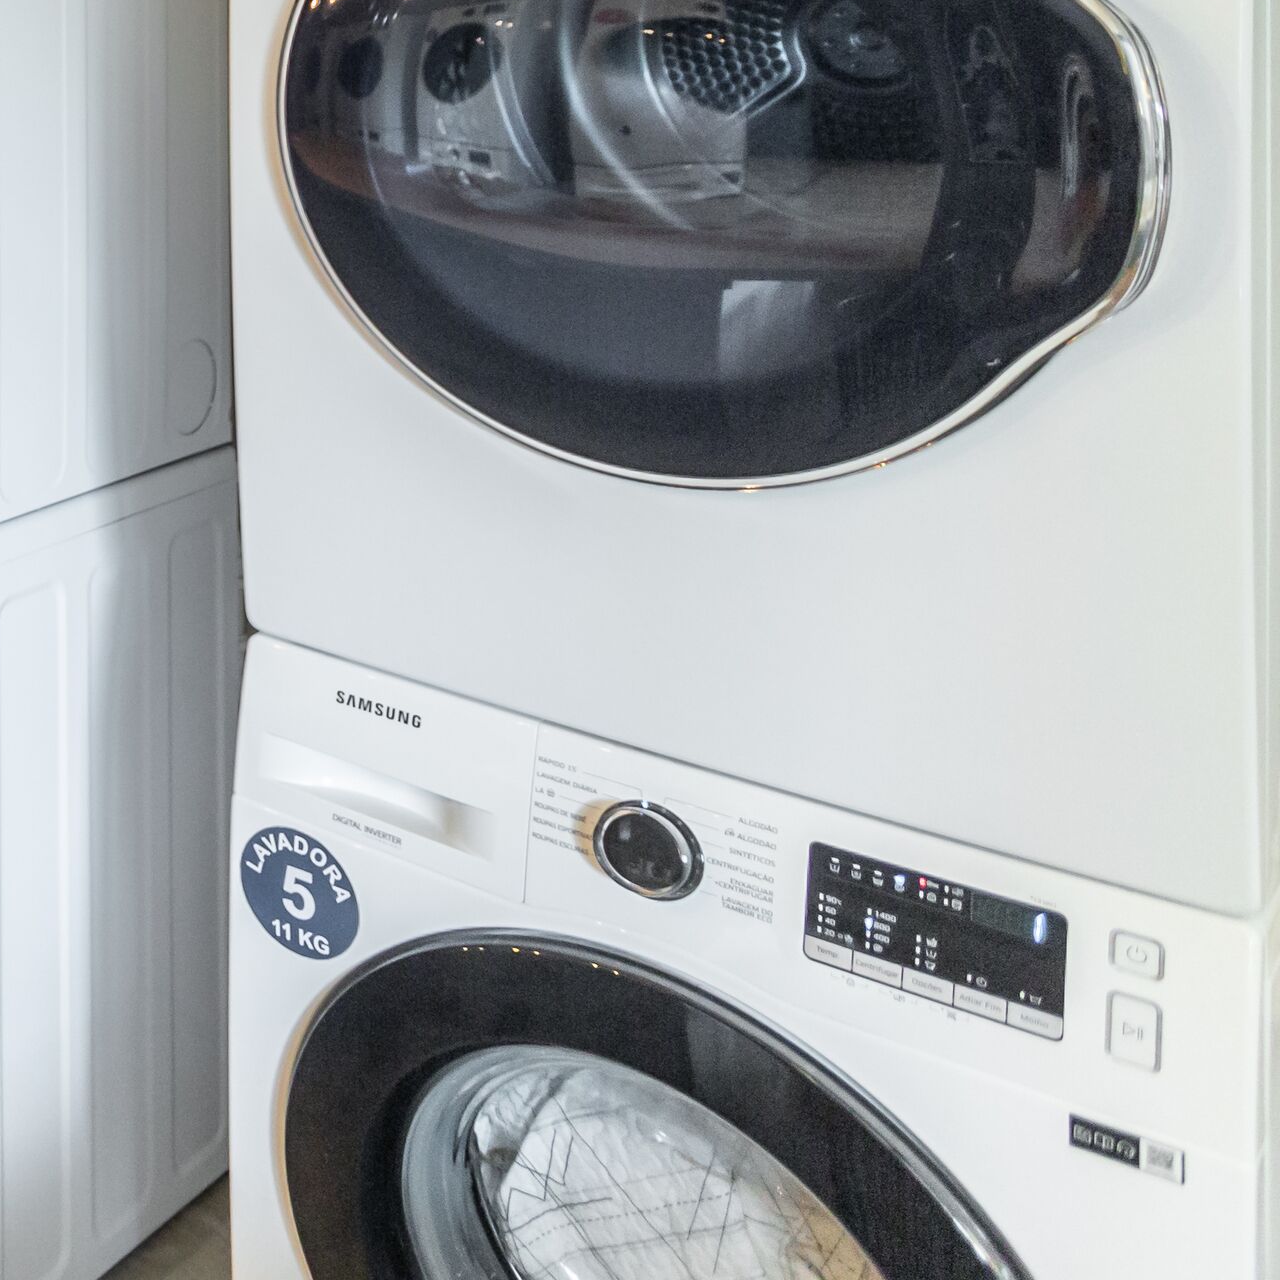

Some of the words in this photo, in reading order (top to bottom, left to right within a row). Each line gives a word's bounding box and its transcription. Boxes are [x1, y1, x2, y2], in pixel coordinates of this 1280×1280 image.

[336, 690, 421, 729] SAMSUNG
[332, 813, 362, 831] DIGITAL
[364, 825, 402, 845] INVERTER
[246, 833, 351, 904] LAVADORA
[282, 865, 316, 920] 5
[825, 906, 836, 915] 60
[875, 910, 897, 923] 1400
[824, 927, 835, 937] 20
[825, 917, 836, 927] 40
[272, 919, 291, 941] 11
[298, 928, 330, 955] KG
[873, 933, 890, 944] 400
